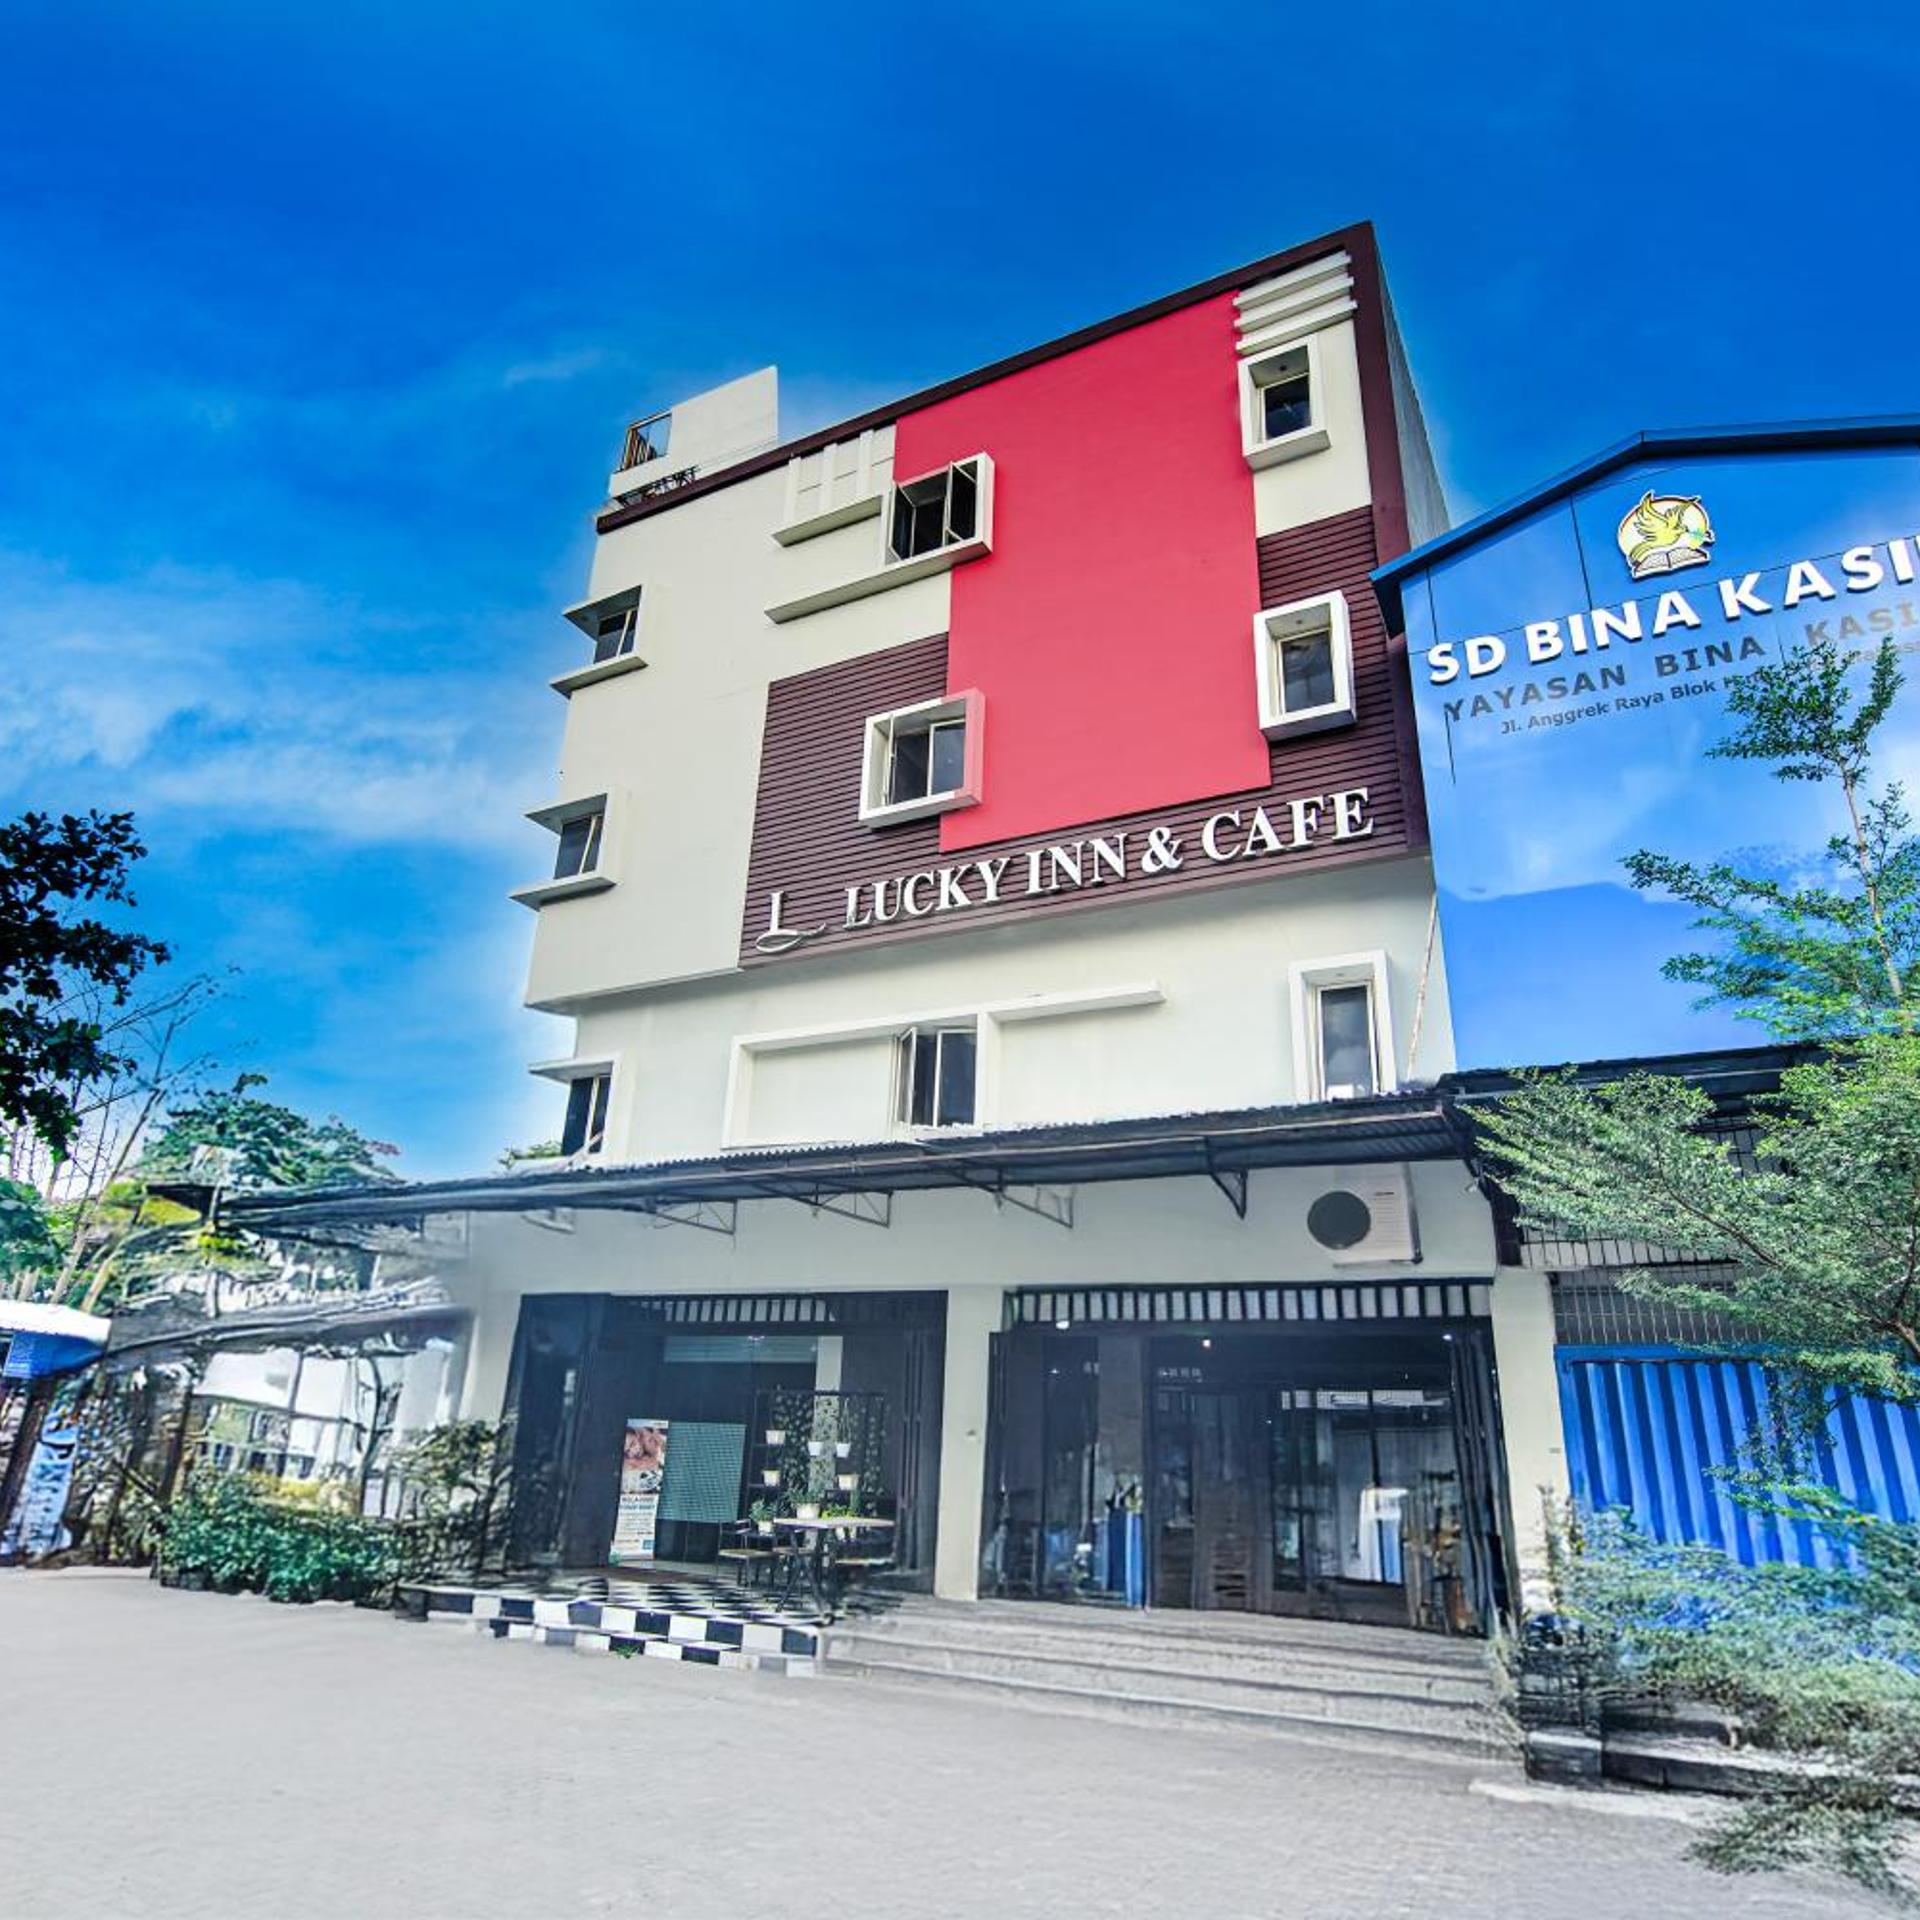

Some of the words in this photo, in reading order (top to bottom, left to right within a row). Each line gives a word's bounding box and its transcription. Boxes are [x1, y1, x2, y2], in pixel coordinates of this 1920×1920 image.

[1428, 635, 1506, 684] SD
[1524, 591, 1701, 663] BINA
[1718, 536, 1920, 619] KASI
[1444, 664, 1625, 722] YAYASAN
[1655, 636, 1766, 677] BINA
[1527, 701, 1610, 731] Anggrek
[1616, 691, 1664, 711] Raya
[1670, 679, 1717, 700] Blok
[842, 857, 1010, 929] LUCKY
[1025, 832, 1129, 895] INN
[1140, 826, 1184, 874] &
[1201, 787, 1374, 861] CAFE
